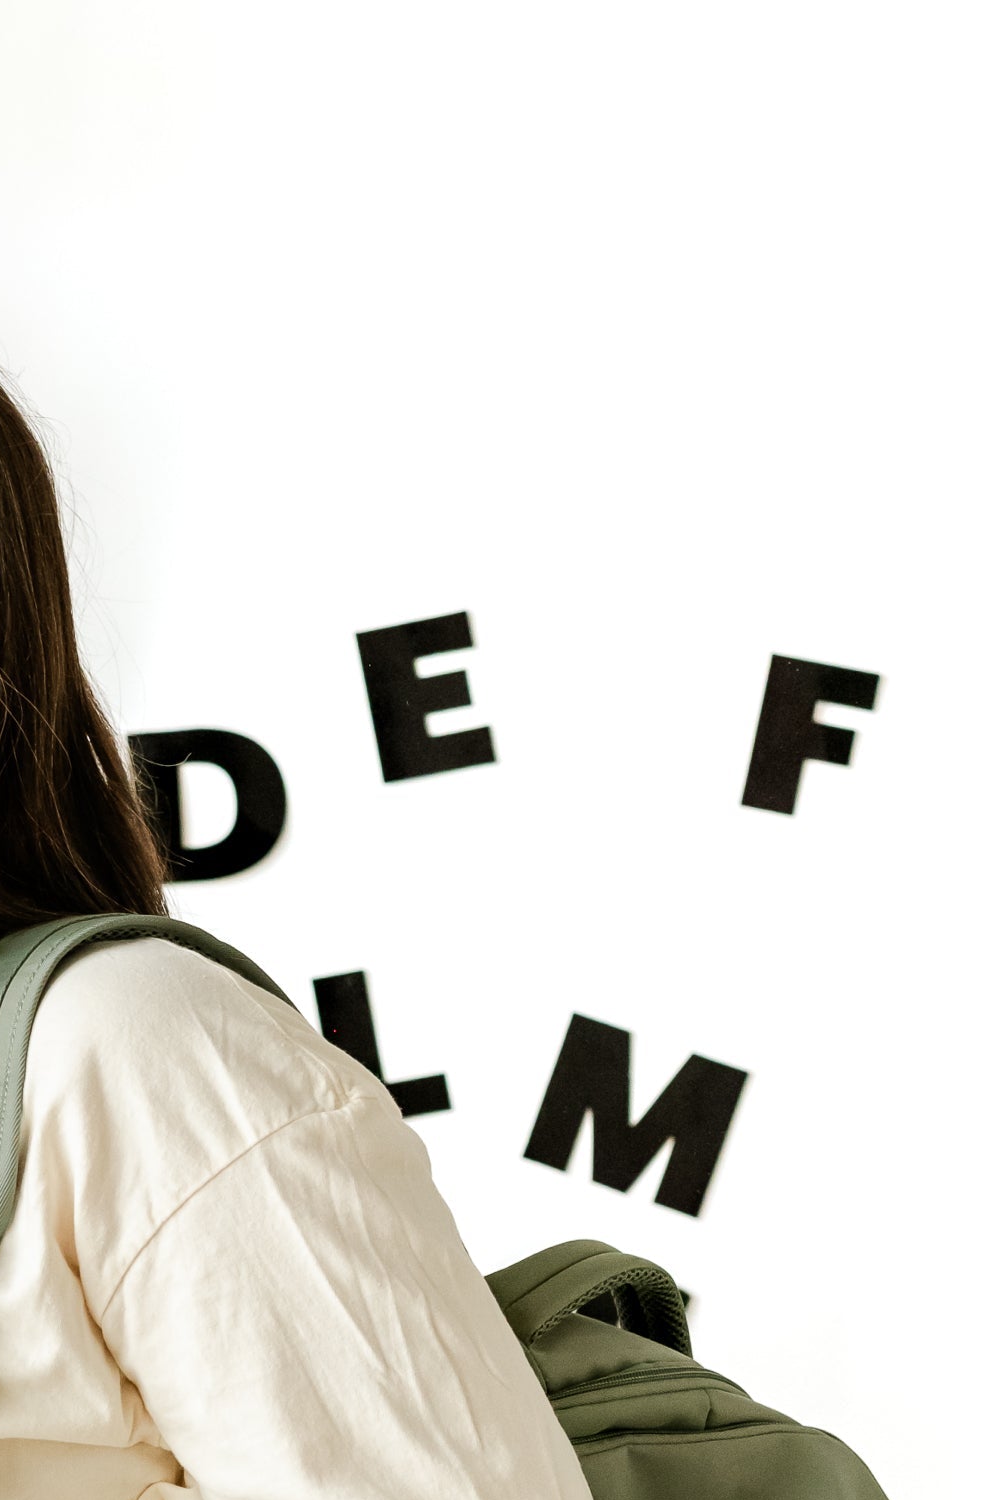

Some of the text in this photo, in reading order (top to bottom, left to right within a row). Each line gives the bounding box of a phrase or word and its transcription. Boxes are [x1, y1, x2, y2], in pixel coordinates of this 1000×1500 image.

[128, 727, 288, 885] D
[356, 611, 496, 783] E
[741, 654, 880, 815] F
[312, 970, 452, 1119] L
[523, 1013, 749, 1219] M
